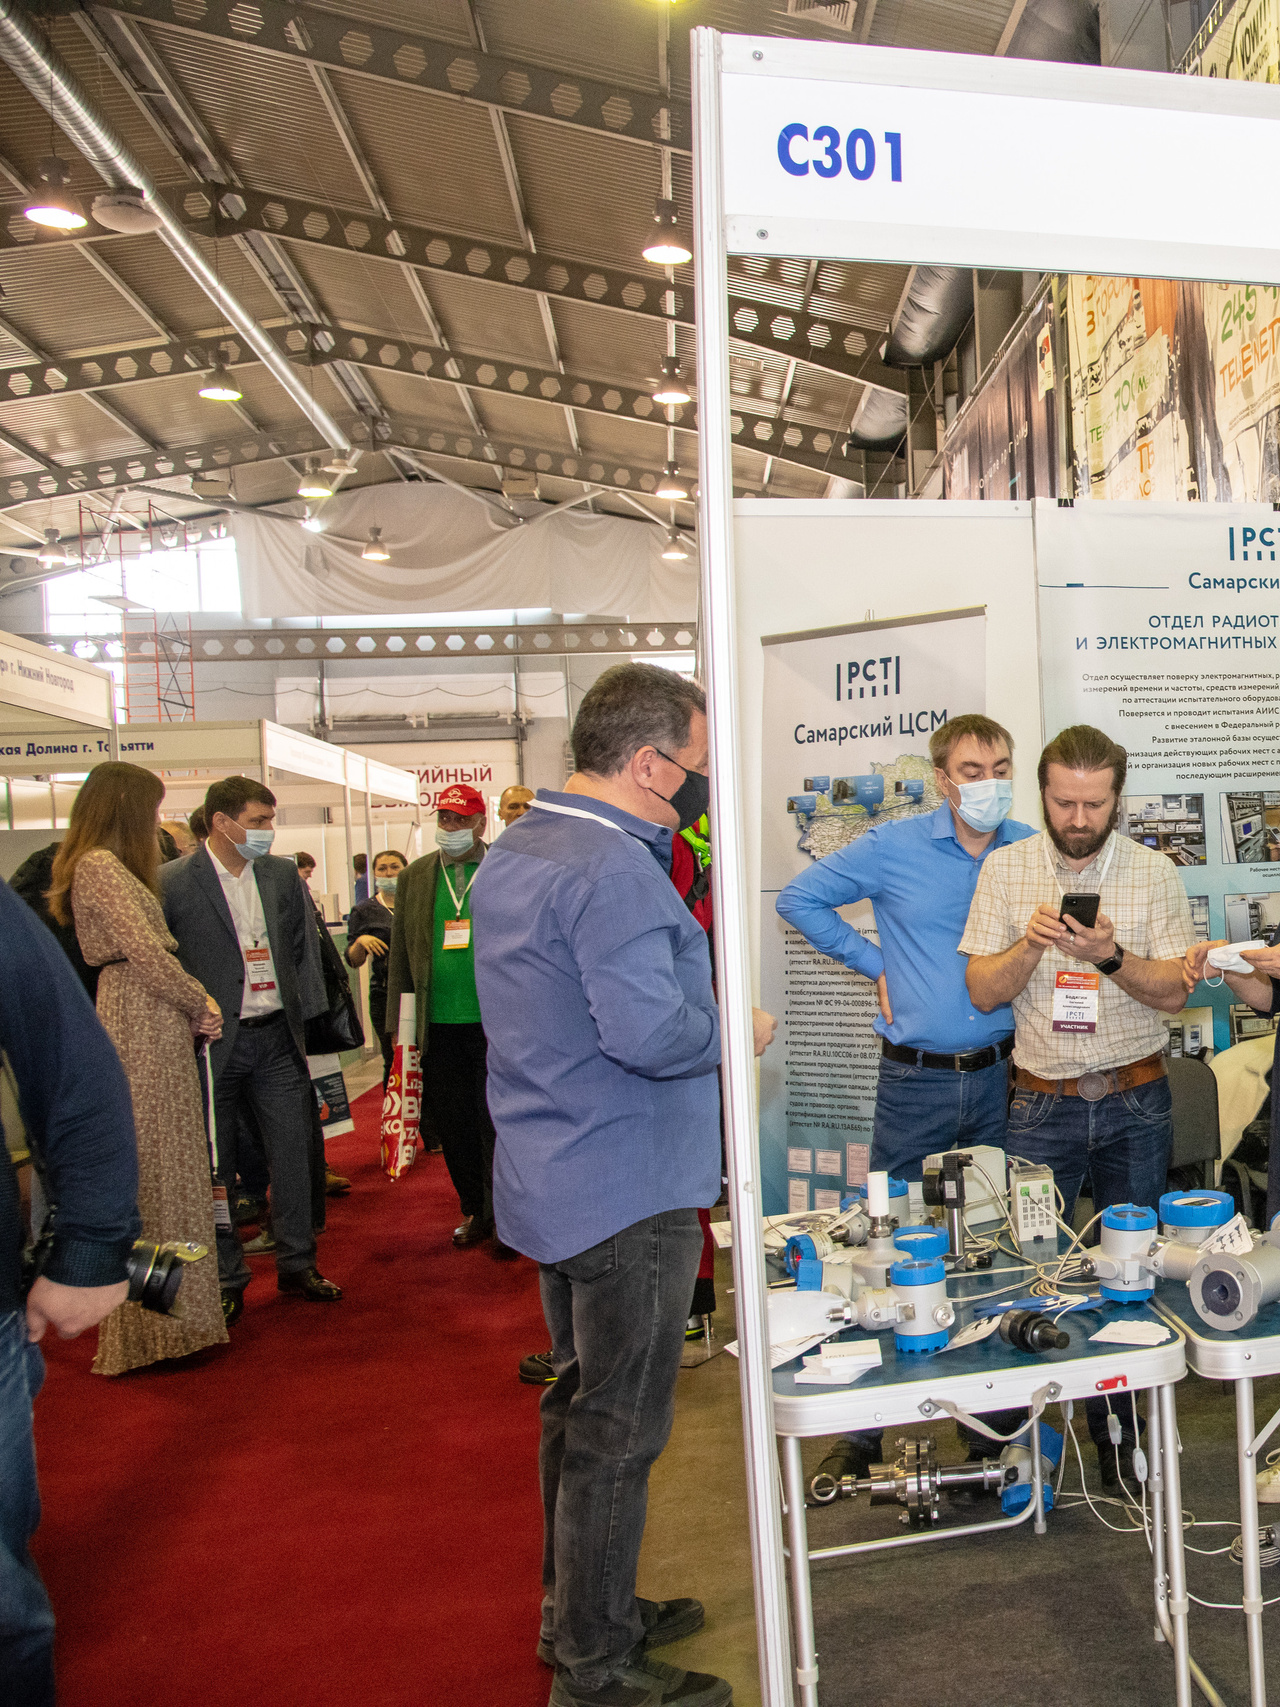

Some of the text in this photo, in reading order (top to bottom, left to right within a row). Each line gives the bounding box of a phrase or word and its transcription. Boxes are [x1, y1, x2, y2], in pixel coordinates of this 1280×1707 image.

[777, 122, 902, 182] С301
[1149, 615, 1203, 630] ОТДЕЛ
[1076, 637, 1087, 650] И
[1096, 636, 1277, 650] ЭЛЕКТРОМАГНИТНЫХ
[848, 656, 892, 684] РСТ
[1082, 673, 1109, 681] Отдел
[1200, 673, 1275, 681] электромагнитных,
[1083, 684, 1128, 694] измерений
[1237, 683, 1280, 691] измерений
[1118, 709, 1165, 718] Поверяется
[1173, 710, 1211, 718] проводит
[1255, 707, 1280, 715] АИИС
[795, 709, 948, 746] Самарский ЦСМ
[1152, 736, 1188, 744] Развитие
[1190, 734, 1231, 743] эталонной
[1232, 734, 1251, 742] базы
[26, 743, 78, 756] Долина
[83, 744, 92, 753] г.
[97, 741, 154, 752] Тоьятти
[404, 764, 492, 784] ИЙНЫЙ
